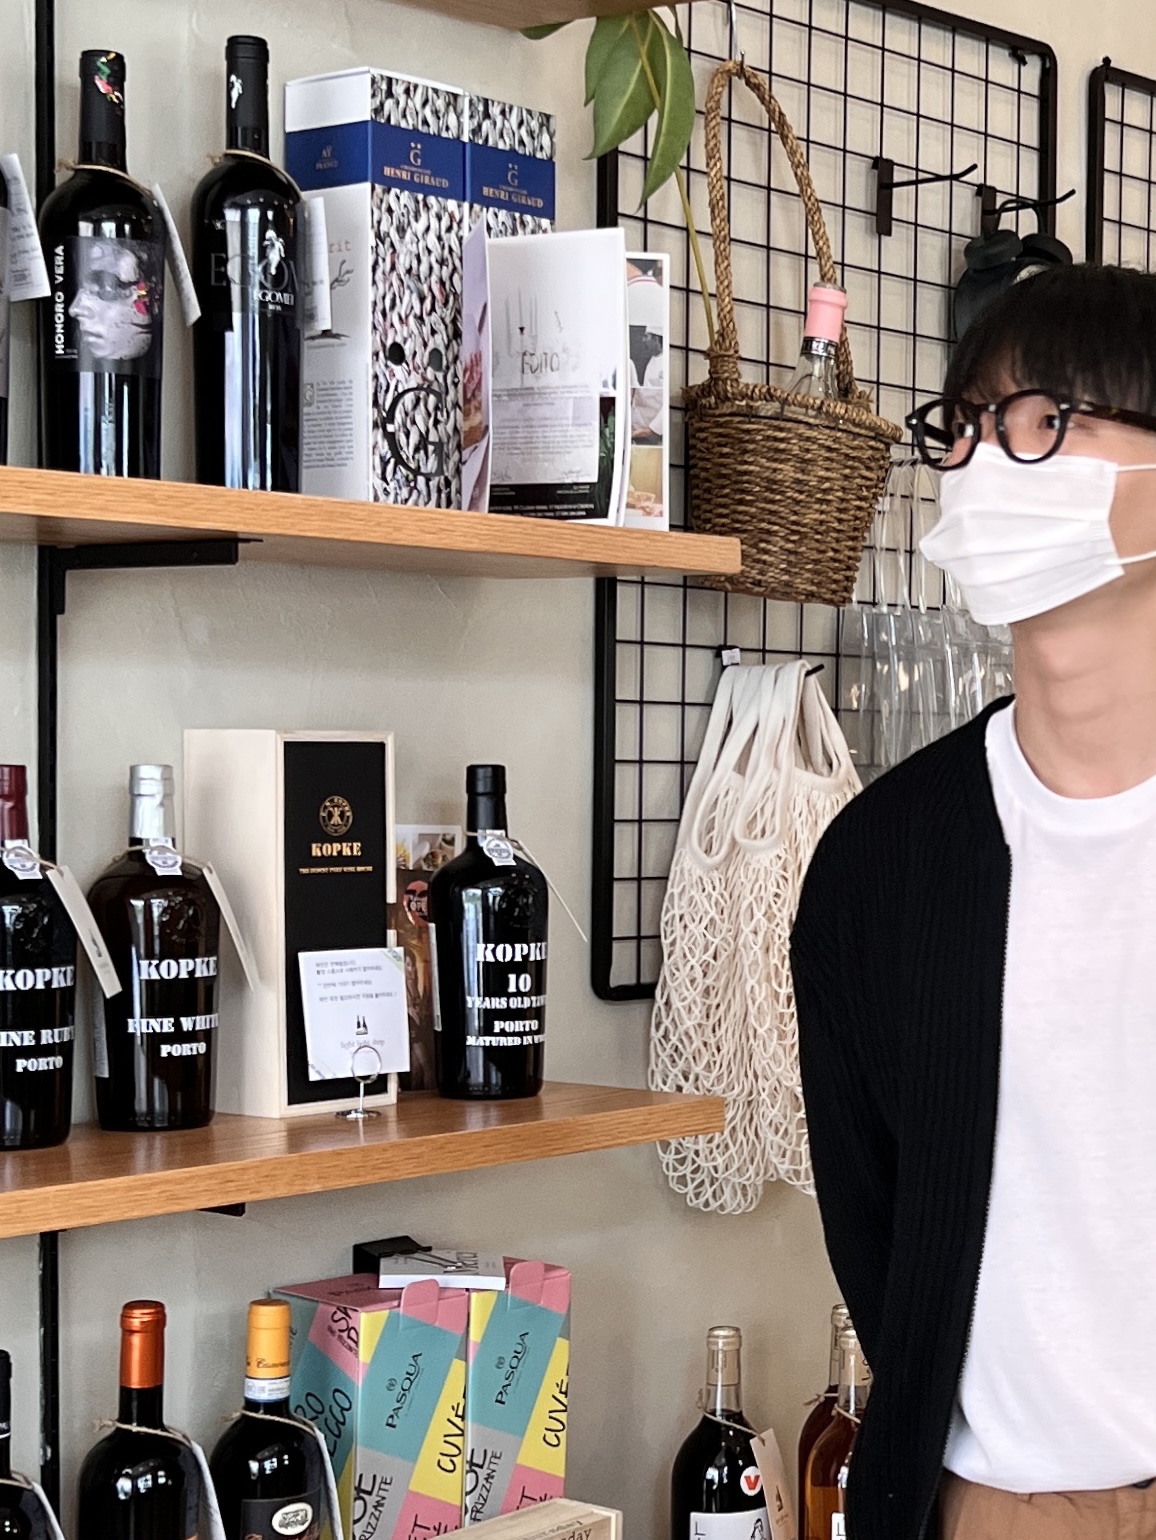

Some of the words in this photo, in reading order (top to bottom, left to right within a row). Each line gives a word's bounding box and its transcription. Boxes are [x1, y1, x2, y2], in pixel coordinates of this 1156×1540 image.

[383, 166, 411, 181] HENRI
[413, 172, 449, 188] GIRAUD
[482, 186, 509, 200] HENRI
[511, 192, 544, 208] GIRAUD
[54, 245, 65, 285] VERA
[54, 290, 65, 354] HONORO
[311, 842, 362, 857] KOPKE
[139, 956, 218, 980] KOPKE
[0, 966, 74, 991] KOPKE
[507, 973, 532, 993] 10
[466, 996, 507, 1010] YEARS
[509, 996, 531, 1009] OLD
[127, 1017, 175, 1034] FINE
[493, 1020, 539, 1033] PORTO
[0, 1030, 36, 1047] INE
[466, 1035, 522, 1046] MATURED
[160, 1042, 207, 1058] PORTO
[16, 1056, 64, 1073] PORTO
[495, 1331, 530, 1406] PASQUA
[385, 1352, 423, 1429] PASQUA
